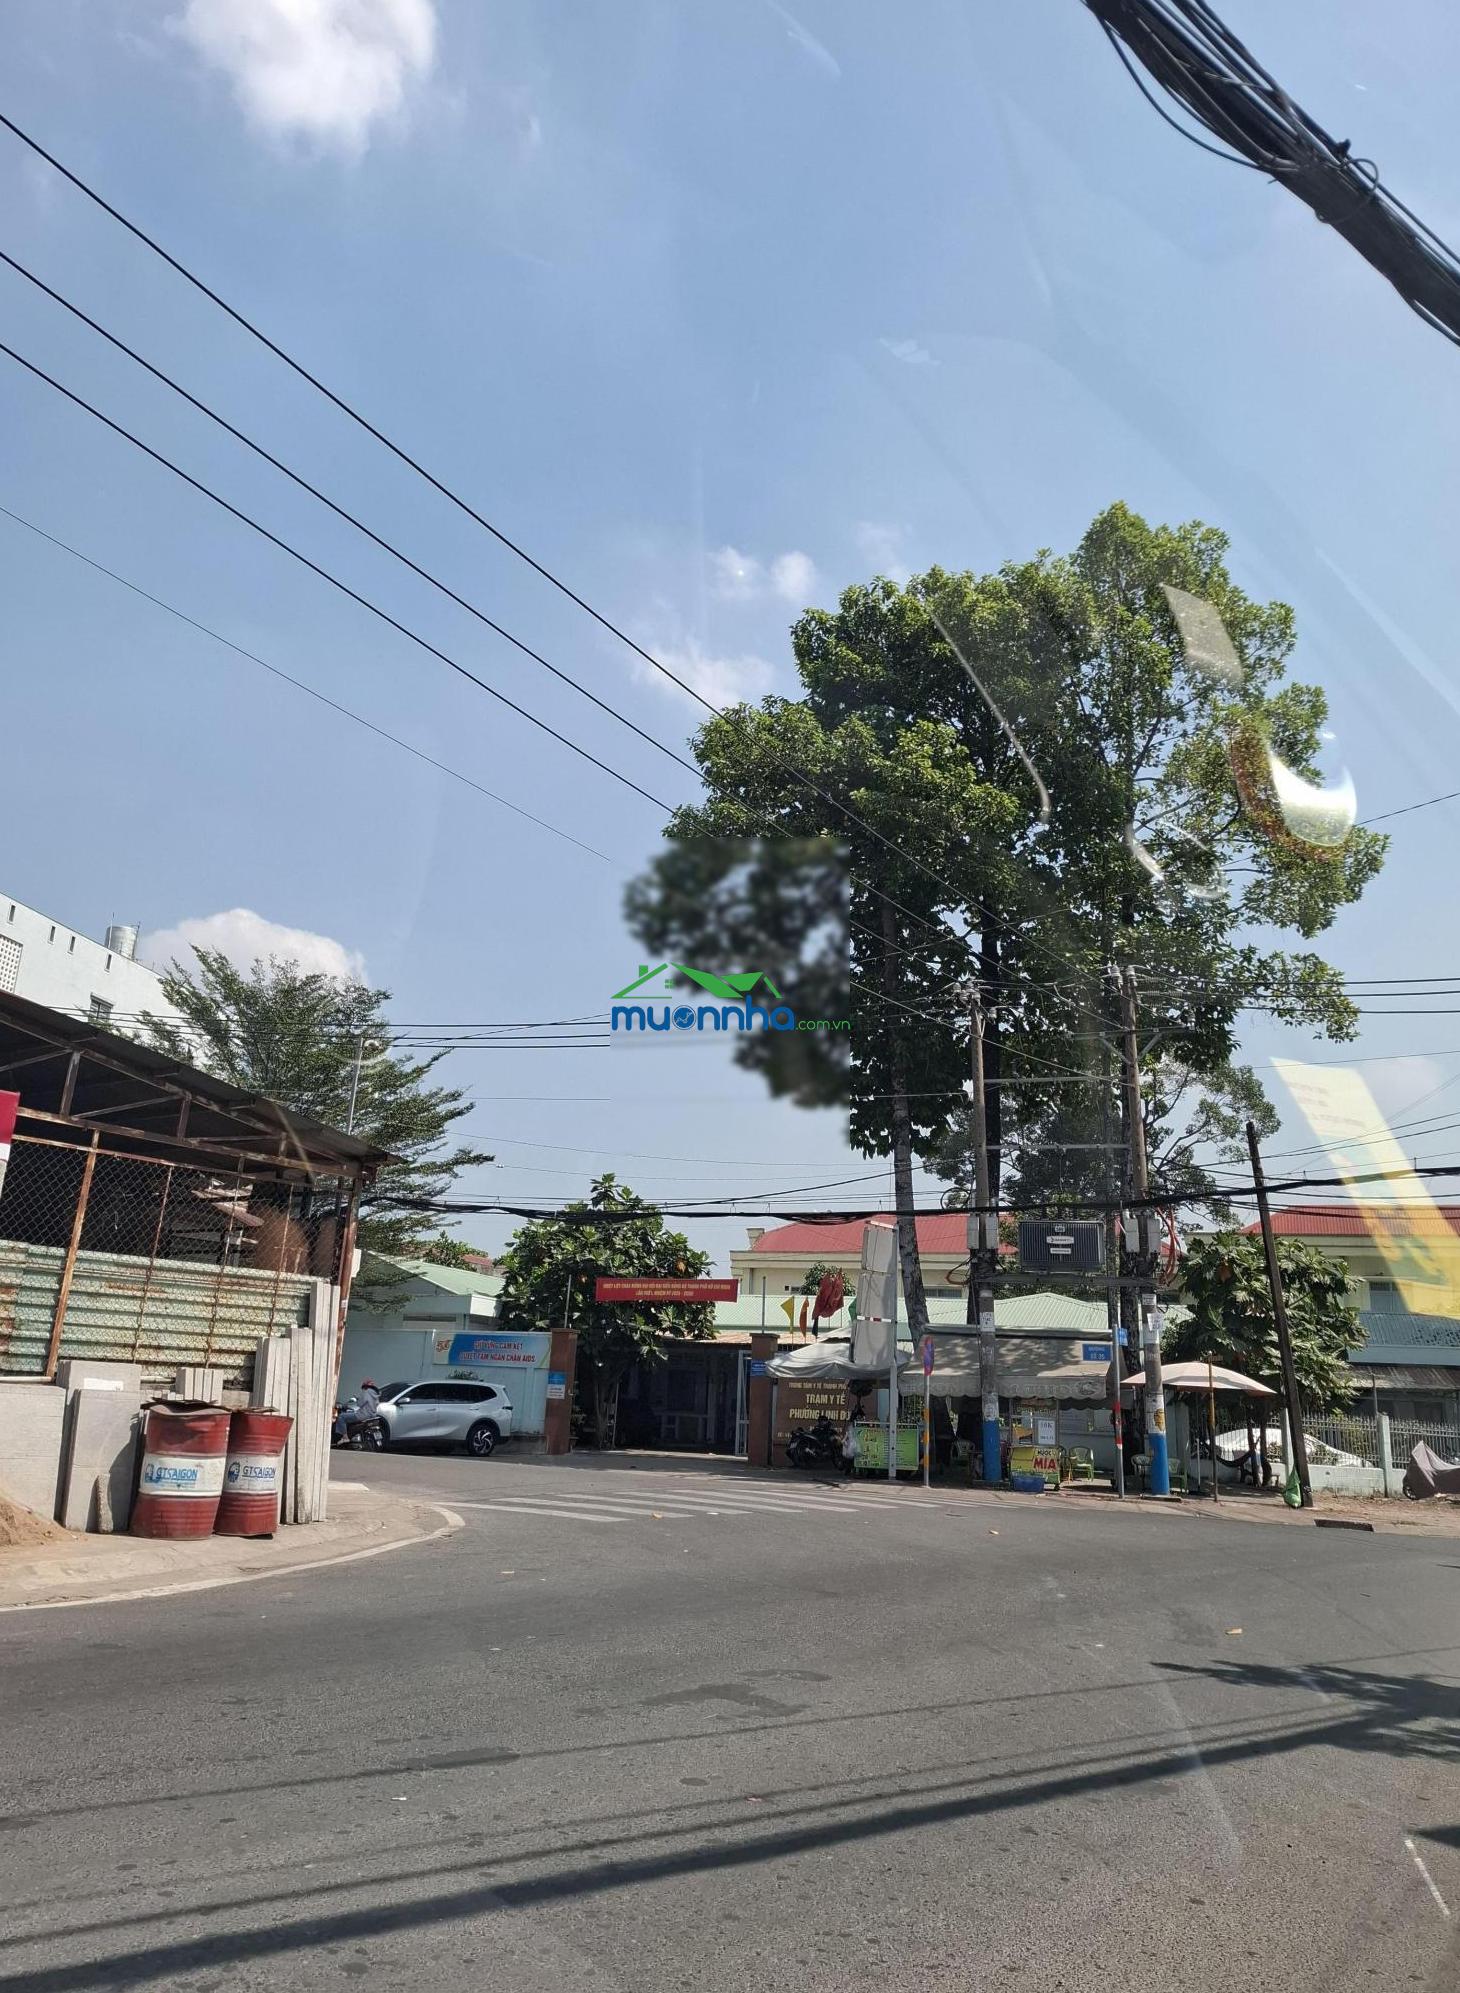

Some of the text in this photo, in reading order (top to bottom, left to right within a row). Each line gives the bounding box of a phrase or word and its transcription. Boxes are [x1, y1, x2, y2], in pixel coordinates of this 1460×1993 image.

[806, 1391, 846, 1407] TRẠM Y TẾ
